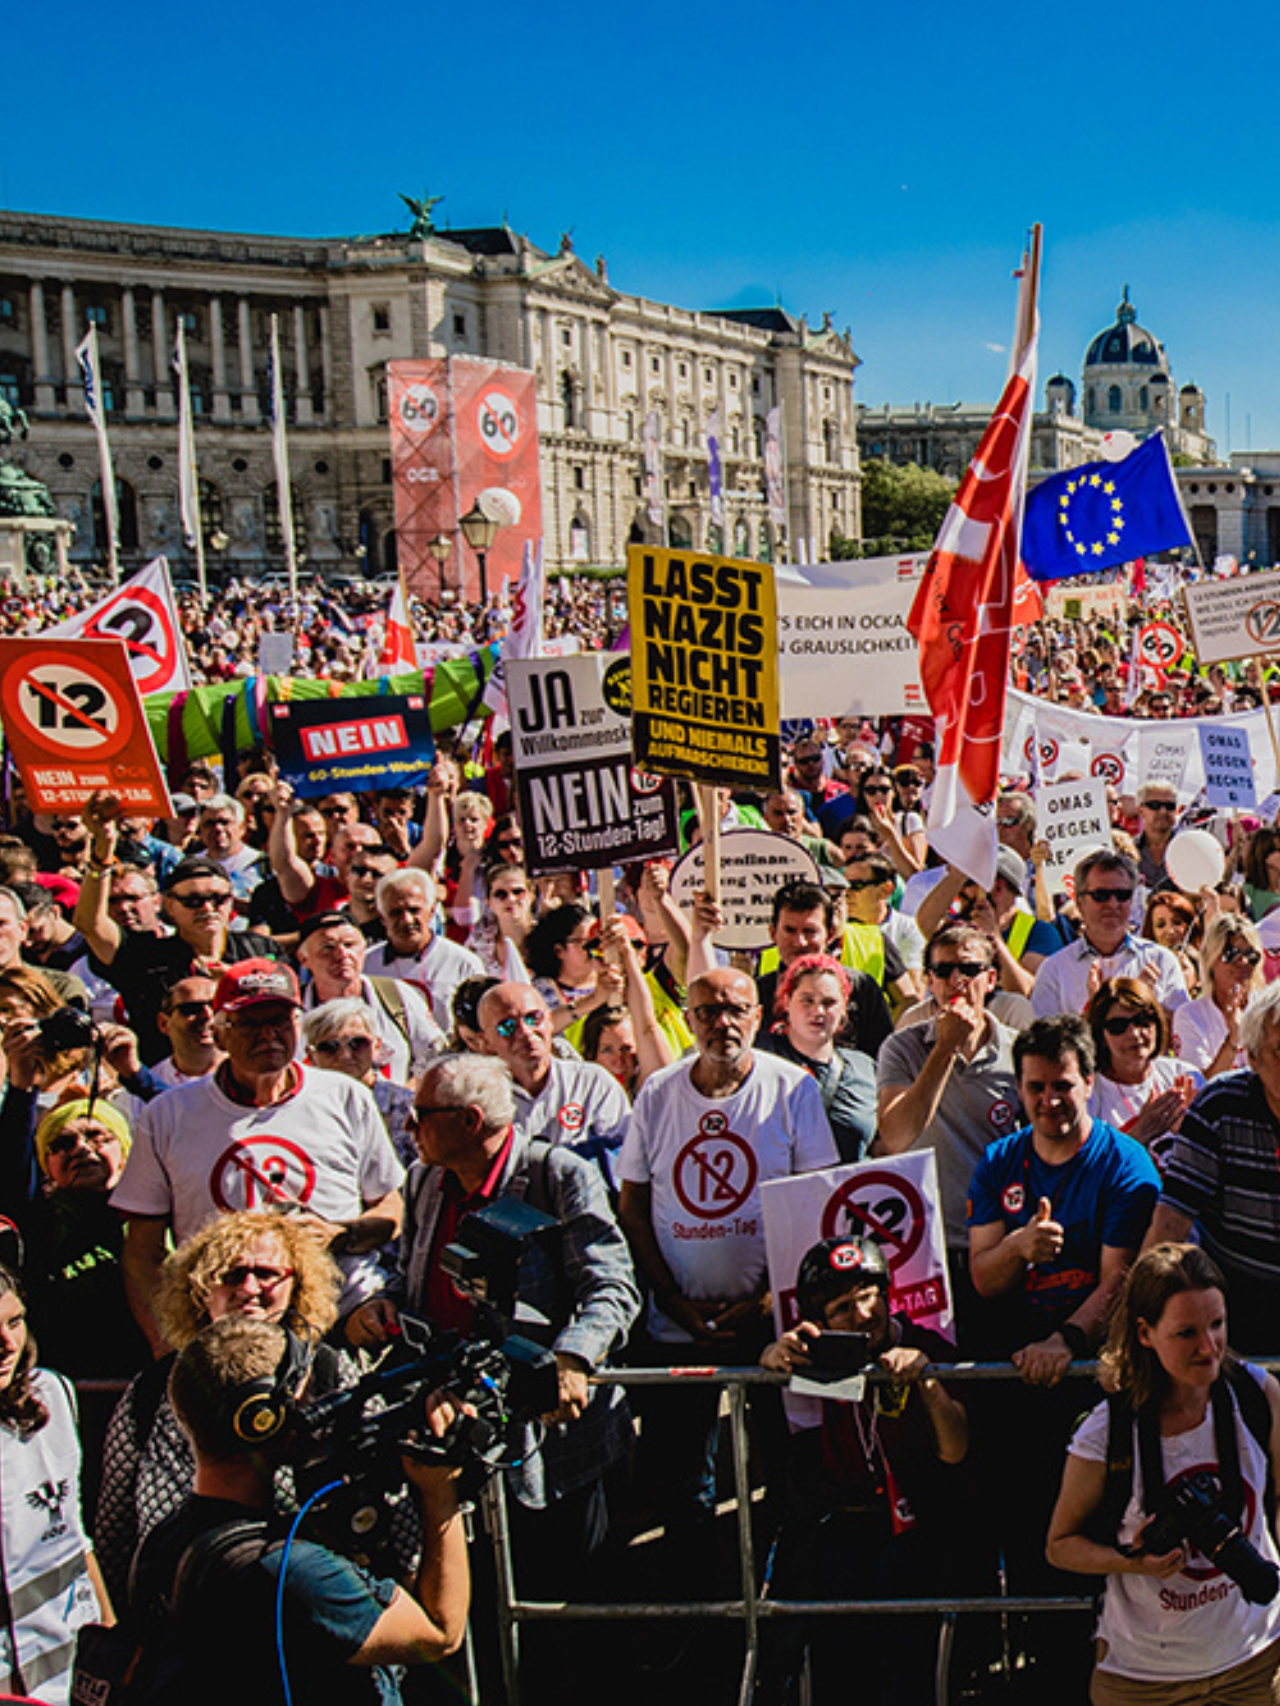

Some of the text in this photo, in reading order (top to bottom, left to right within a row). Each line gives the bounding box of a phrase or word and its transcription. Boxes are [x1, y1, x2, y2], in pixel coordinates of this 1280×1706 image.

[482, 411, 517, 438] 60
[643, 555, 762, 611] LASST
[643, 598, 764, 655] NAZIS
[795, 614, 834, 631] EICH
[837, 615, 855, 630] IN
[646, 641, 763, 699] NICHT
[27, 682, 107, 729] 12
[517, 669, 577, 733] JA
[648, 684, 764, 728] REGIEREN
[580, 707, 606, 727] zur
[308, 720, 403, 757] NEIN
[650, 719, 768, 759] UND NIEMALS
[1205, 733, 1242, 748] OMAS
[308, 759, 432, 782] 60-Stunden-Woche
[1206, 752, 1248, 769] GEGEN
[33, 769, 110, 786] NEIN zum
[1206, 774, 1254, 791] RECHTS
[40, 788, 153, 803] 12-STUNEN-TAG
[529, 764, 631, 835] NEIN
[632, 797, 664, 816] zum
[1047, 792, 1093, 815] OMAS
[537, 812, 668, 858] 12-Stunden-Tag!
[1045, 818, 1101, 842] GEGEN
[692, 1149, 736, 1203] 12
[671, 1218, 758, 1241] Stunden-Tag
[844, 1196, 908, 1245] 12
[837, 1249, 857, 1264] 12
[1158, 1581, 1237, 1613] Stunden-
